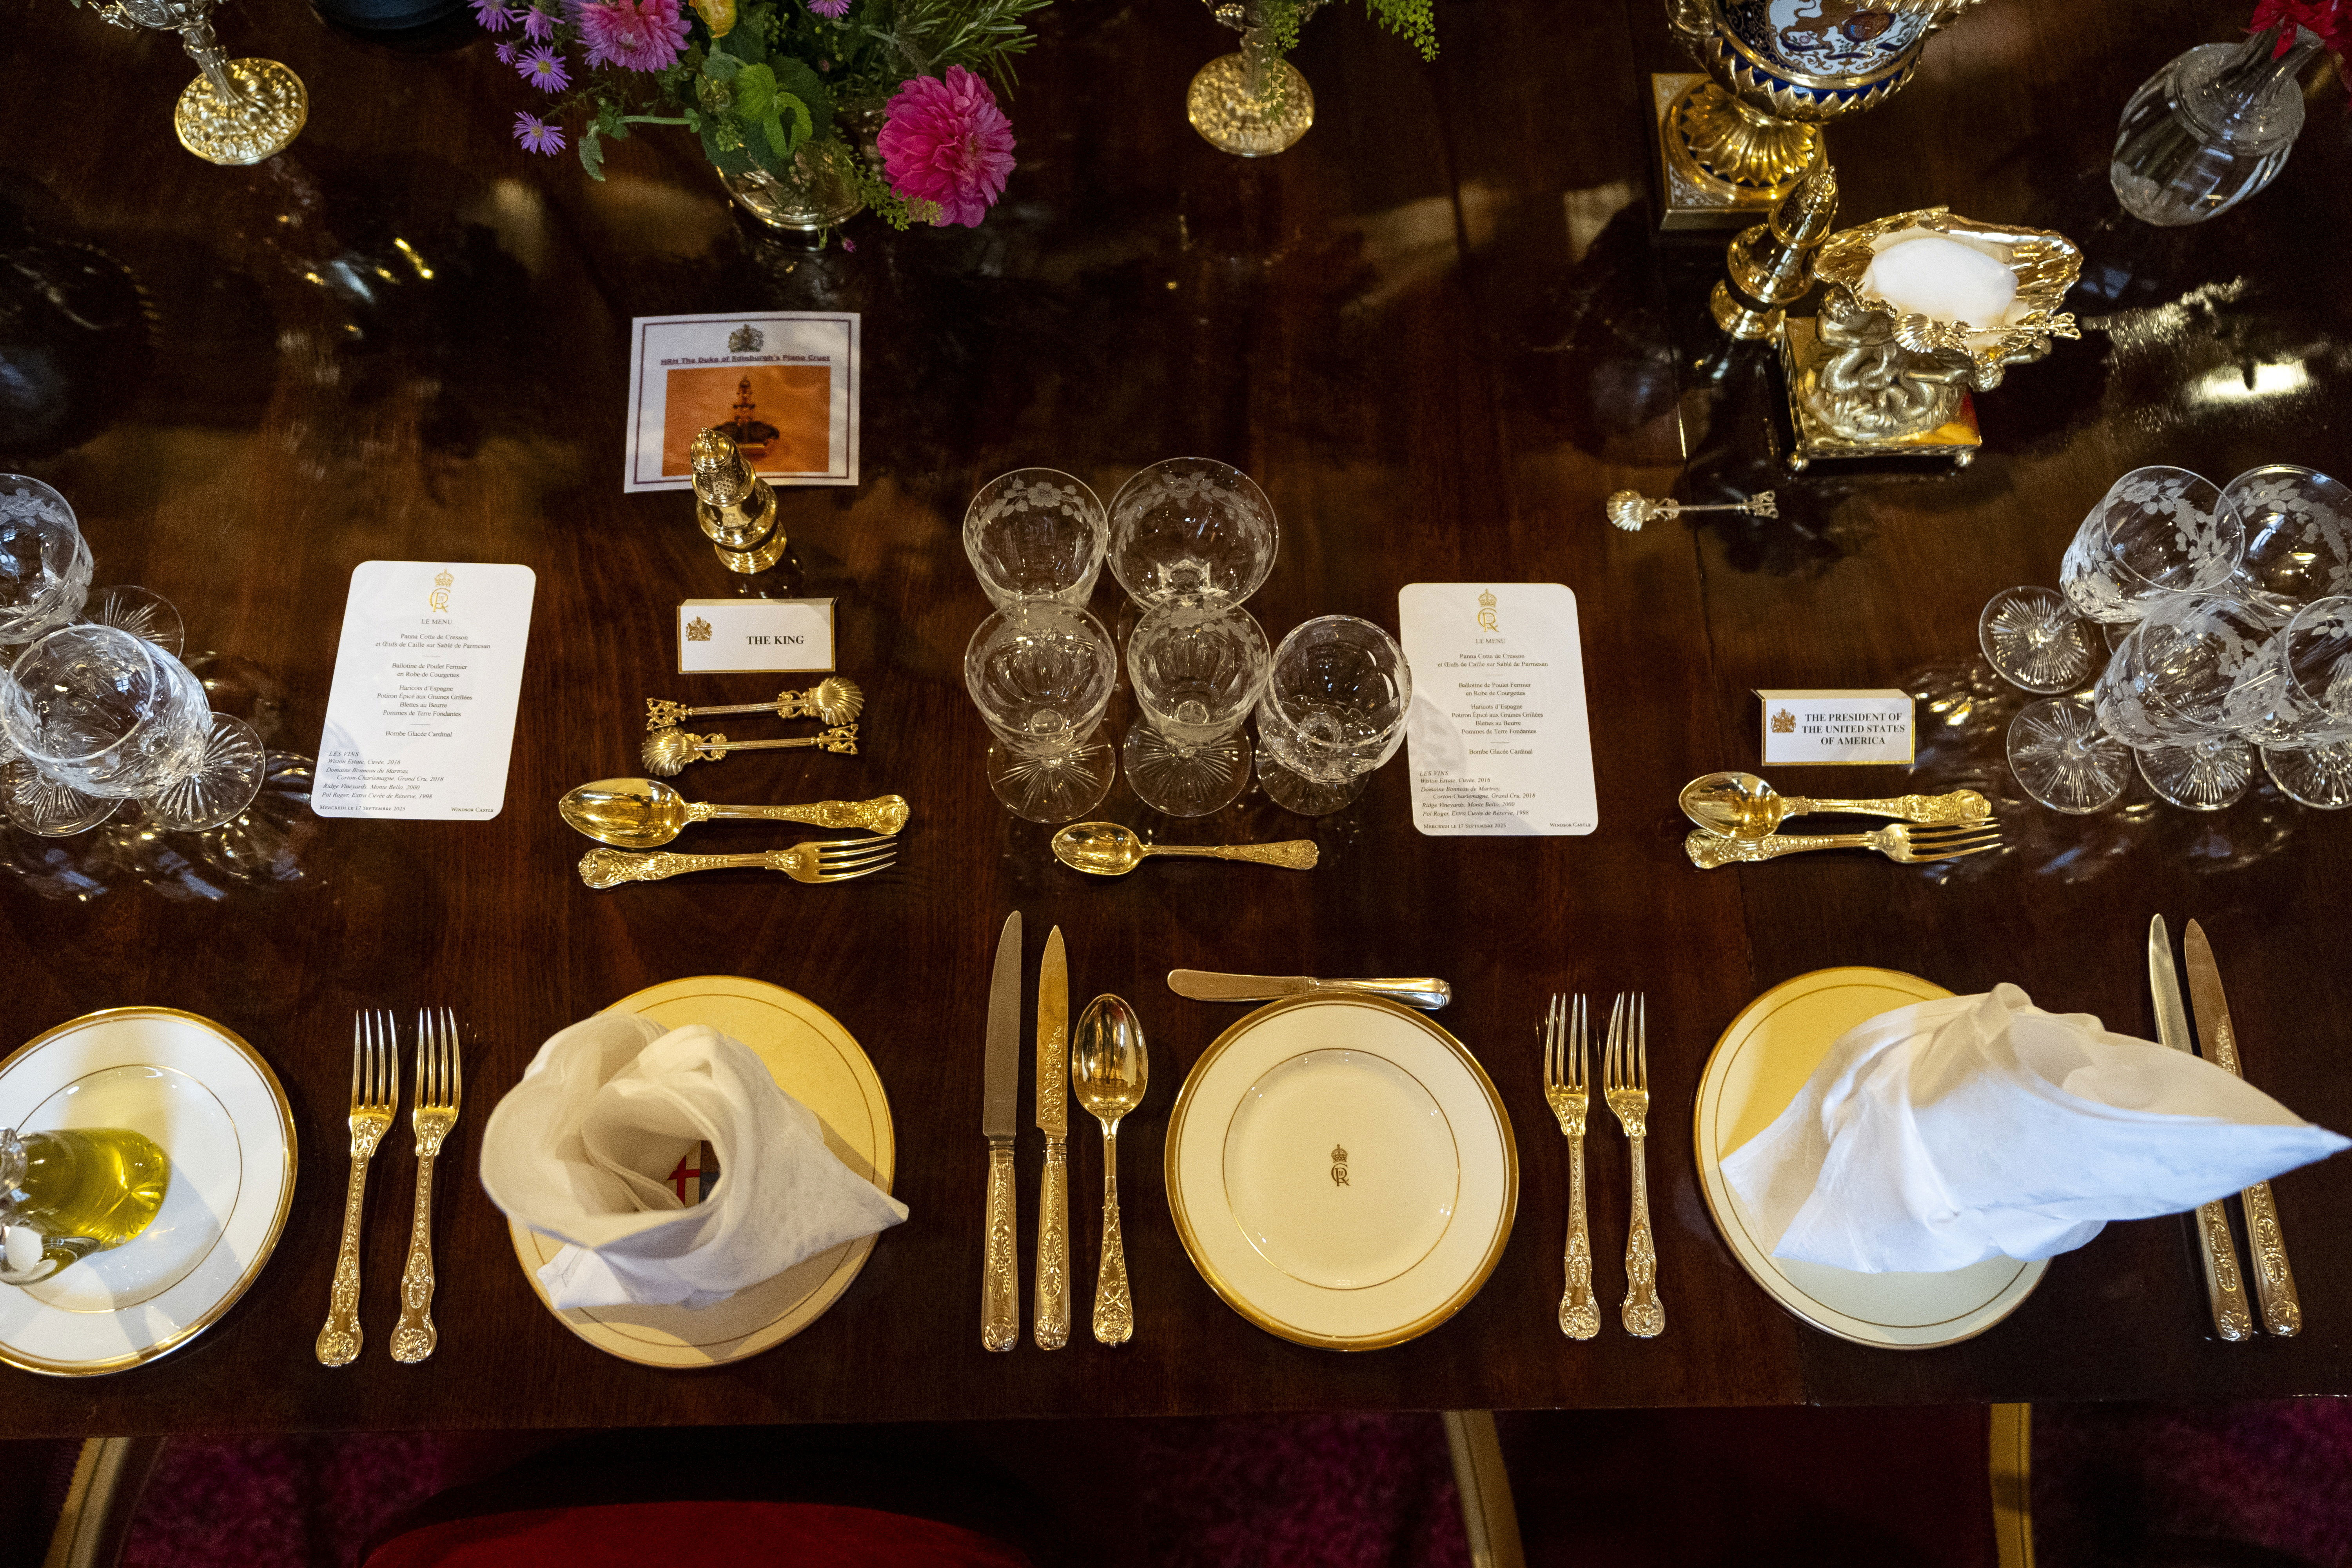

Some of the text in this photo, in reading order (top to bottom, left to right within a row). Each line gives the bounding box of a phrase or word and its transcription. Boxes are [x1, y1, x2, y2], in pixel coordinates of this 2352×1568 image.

[747, 635, 804, 644] THE KING
[1829, 713, 1886, 721] PRESIDENT
